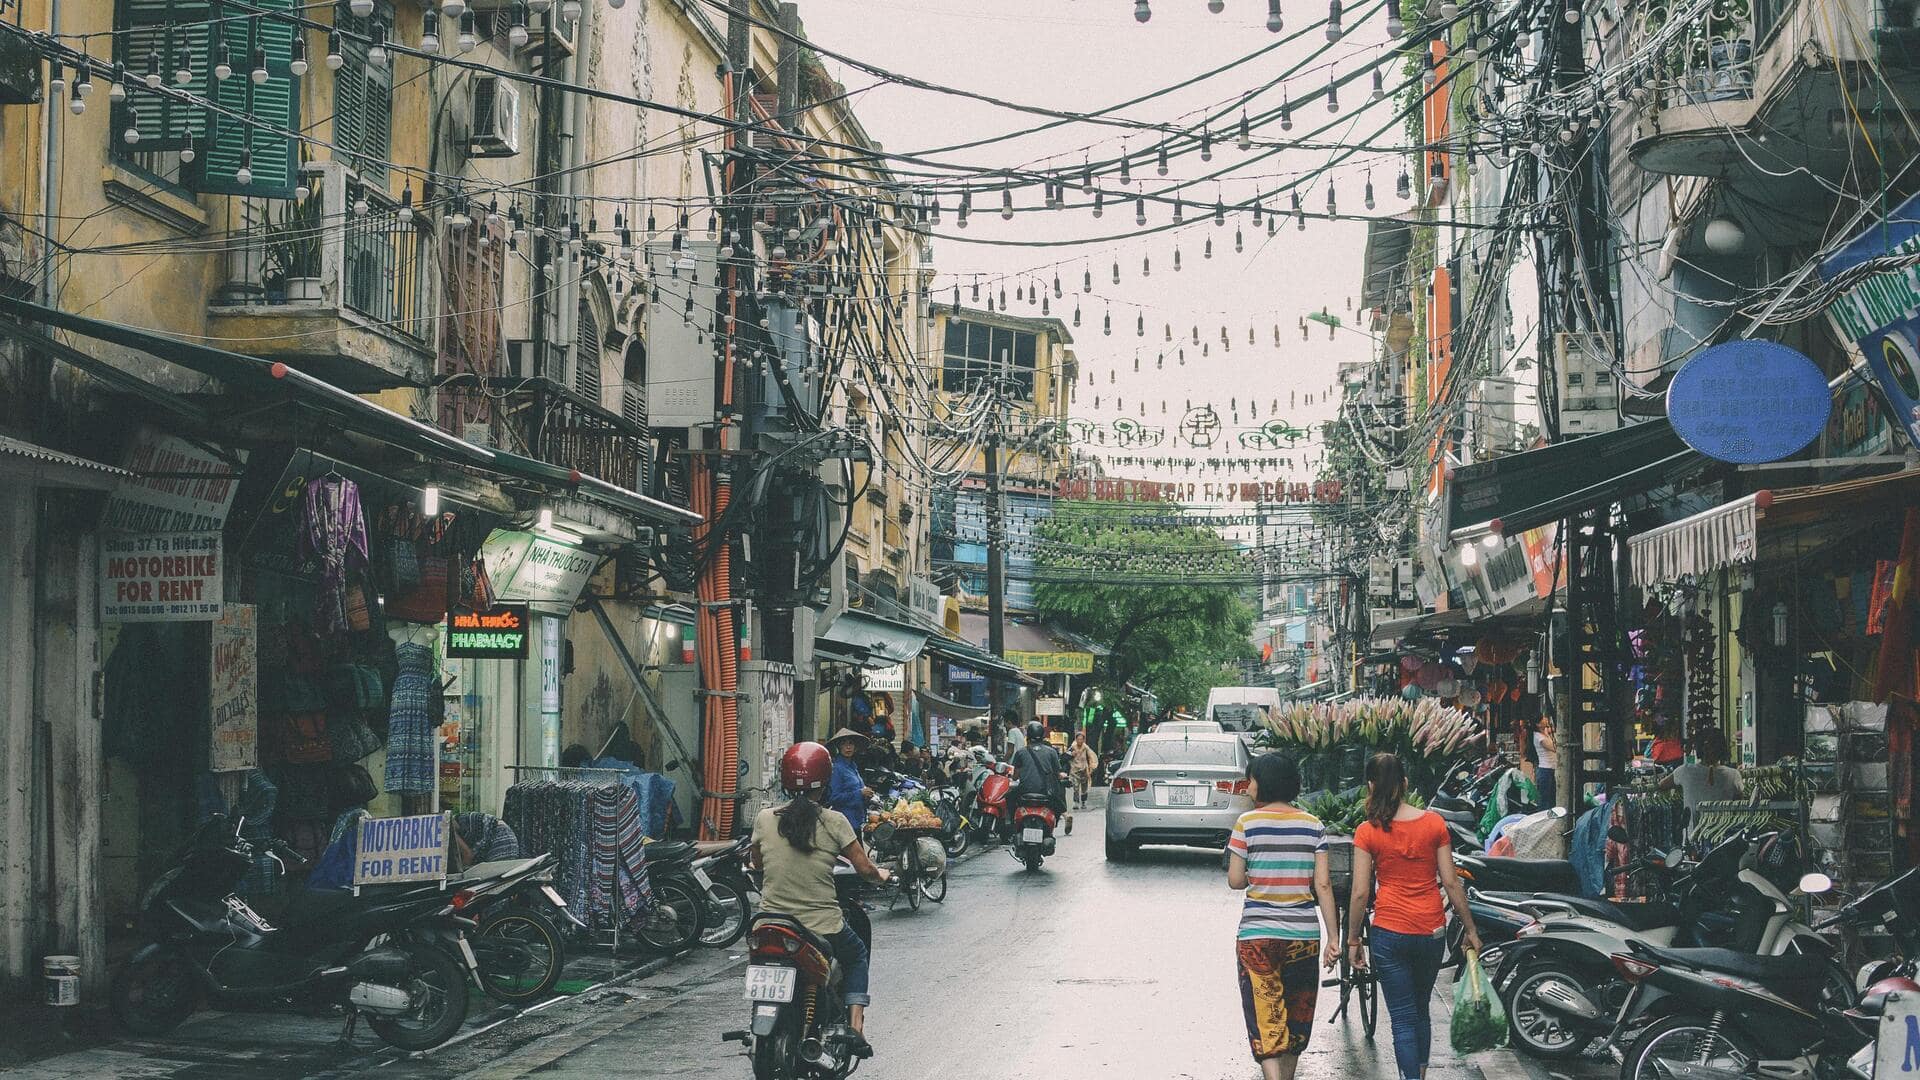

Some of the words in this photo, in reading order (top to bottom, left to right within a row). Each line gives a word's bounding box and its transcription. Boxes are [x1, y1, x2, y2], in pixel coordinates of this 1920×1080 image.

[137, 537, 151, 551] 37
[108, 555, 217, 579] MOTORBIKE
[116, 580, 153, 603] FOR
[158, 579, 204, 602] RENT
[451, 633, 523, 649] PHARMACY
[861, 675, 902, 690] Vietnam
[362, 815, 443, 853] MOTORBIKE
[361, 859, 394, 878] FOR
[398, 855, 443, 875] RENT
[750, 985, 786, 999] 8105
